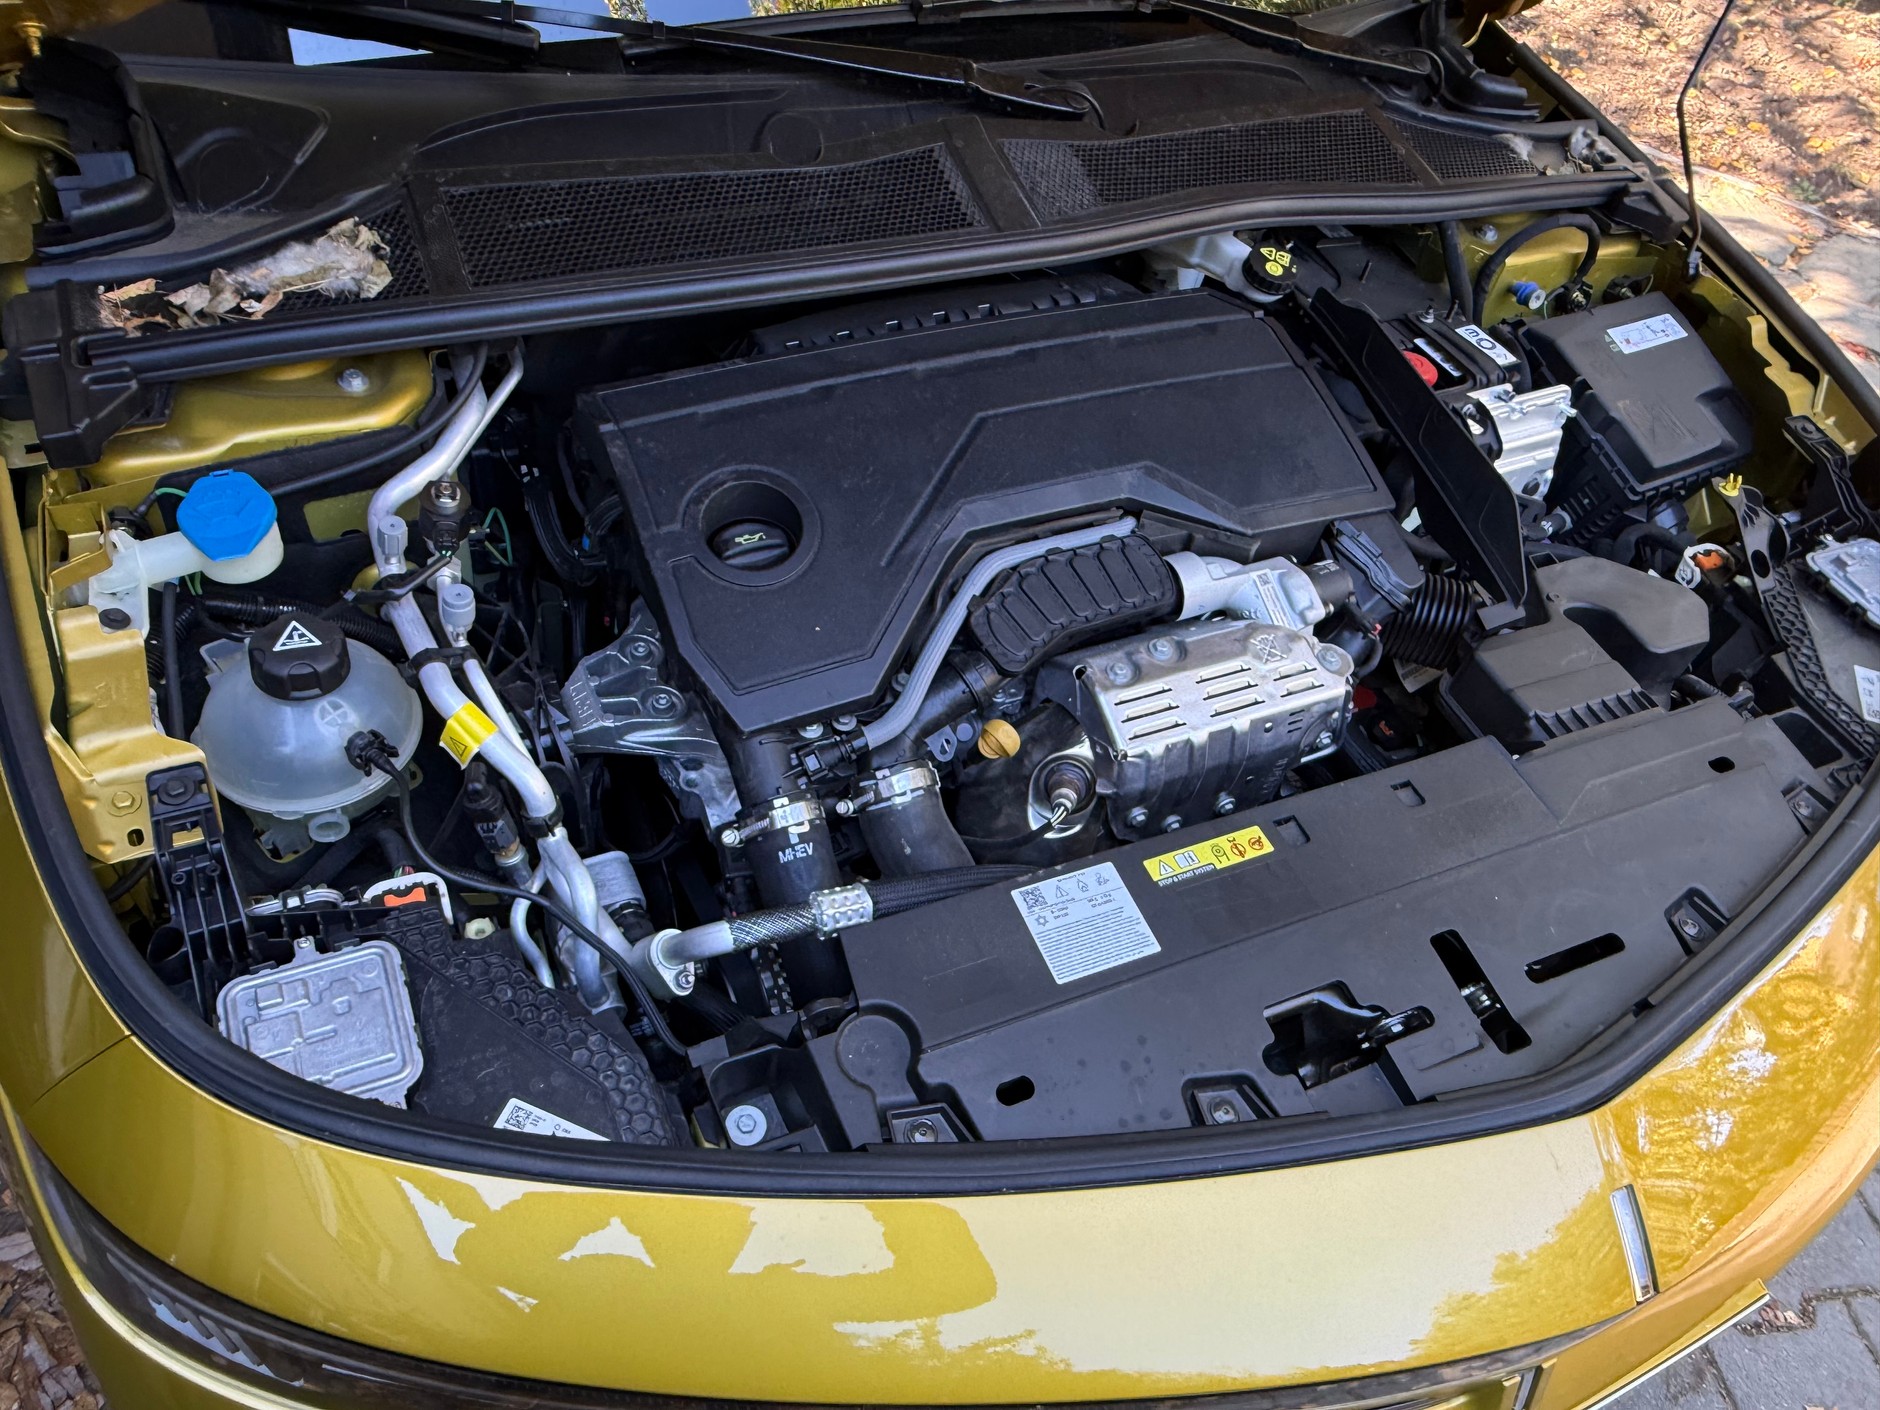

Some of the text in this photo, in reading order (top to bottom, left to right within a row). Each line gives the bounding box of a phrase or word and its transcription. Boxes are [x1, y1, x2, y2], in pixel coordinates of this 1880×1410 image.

[1158, 877, 1173, 887] STOP
[1177, 870, 1195, 880] START
[1193, 864, 1215, 875] SYSTEM
